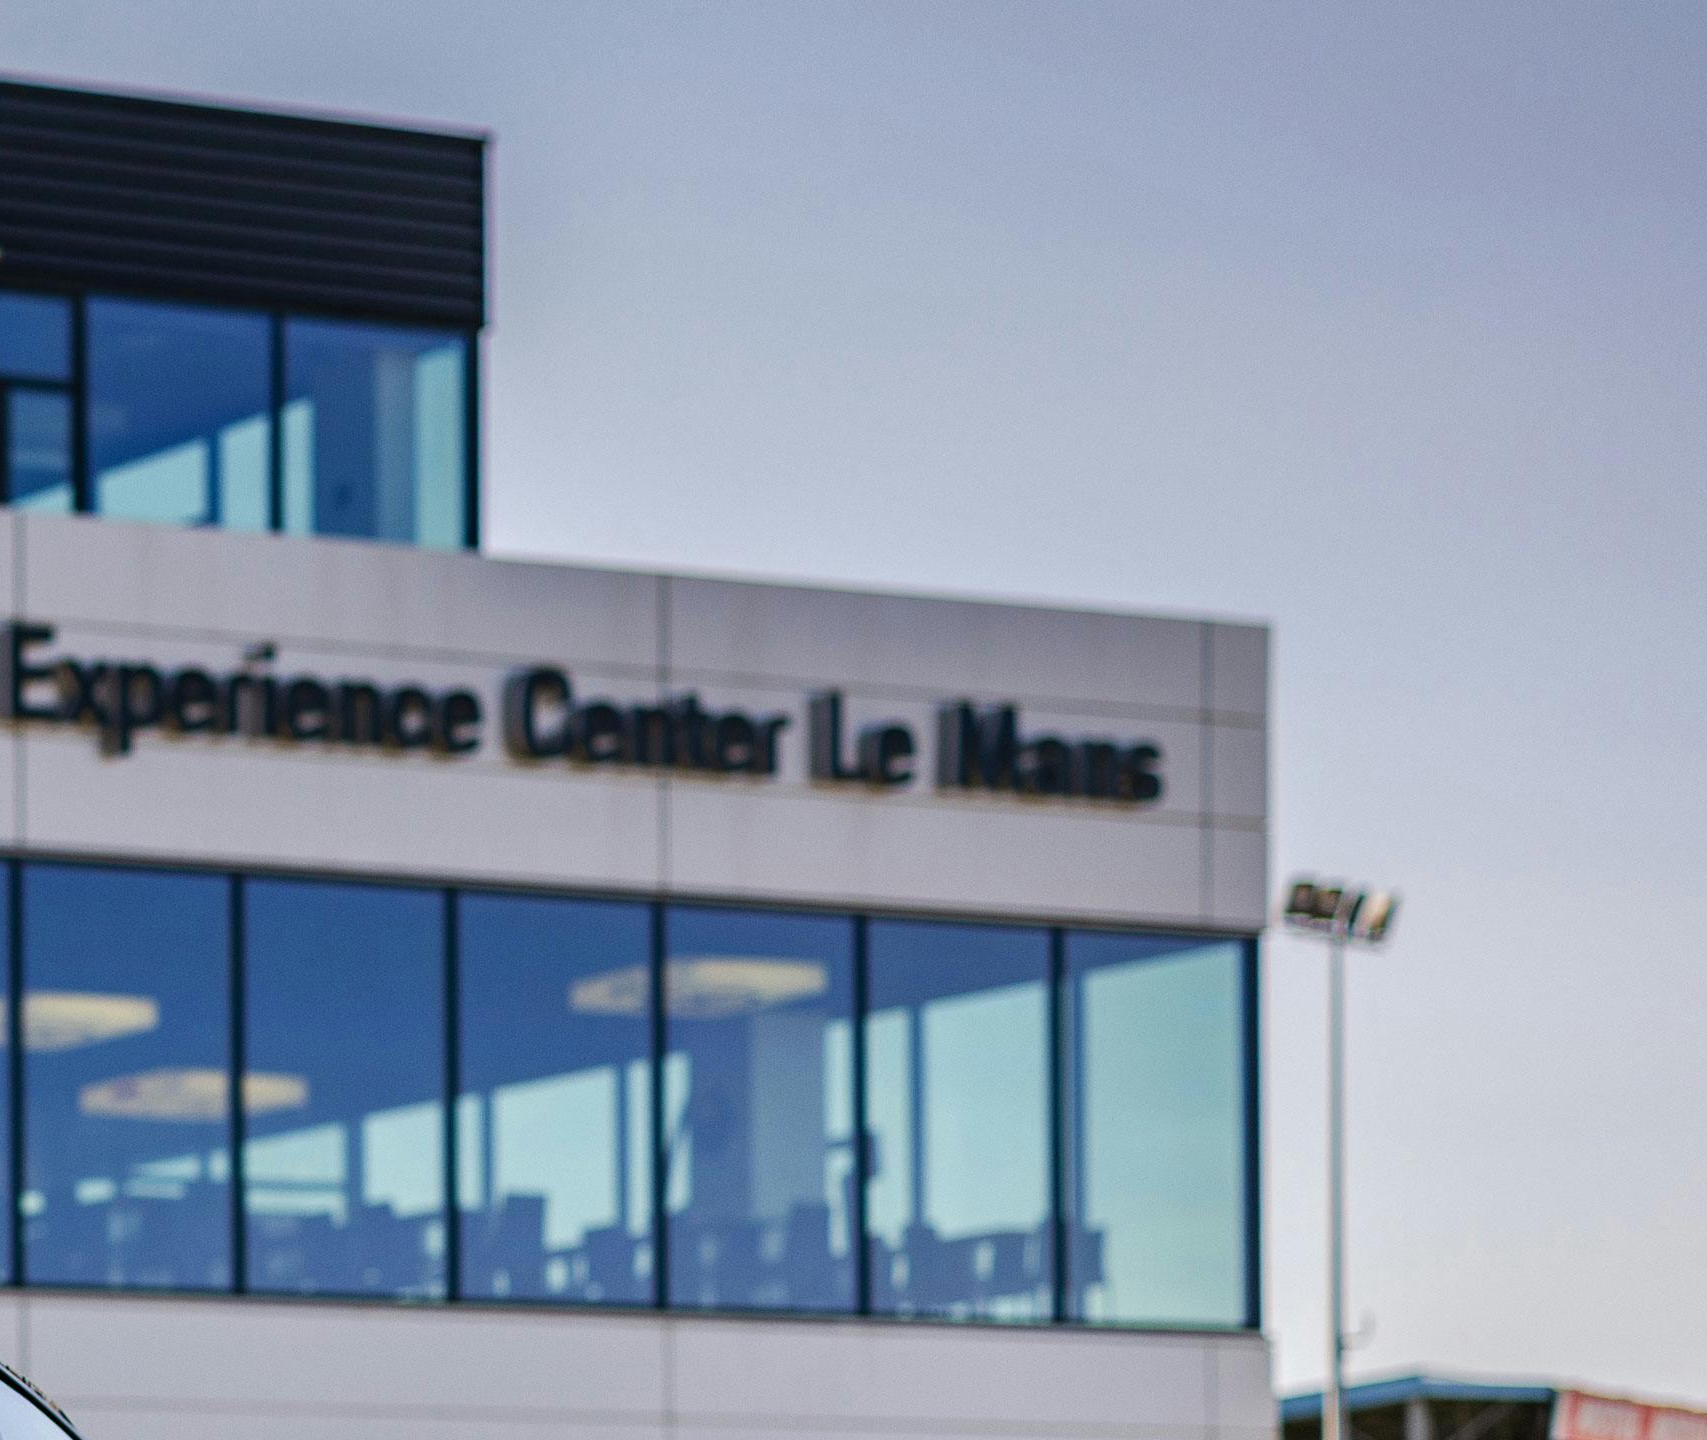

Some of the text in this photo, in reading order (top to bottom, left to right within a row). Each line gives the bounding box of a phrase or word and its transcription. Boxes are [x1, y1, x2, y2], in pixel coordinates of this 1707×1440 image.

[502, 667, 788, 775] Center
[808, 689, 914, 788] Le
[935, 700, 1164, 808] Mans
